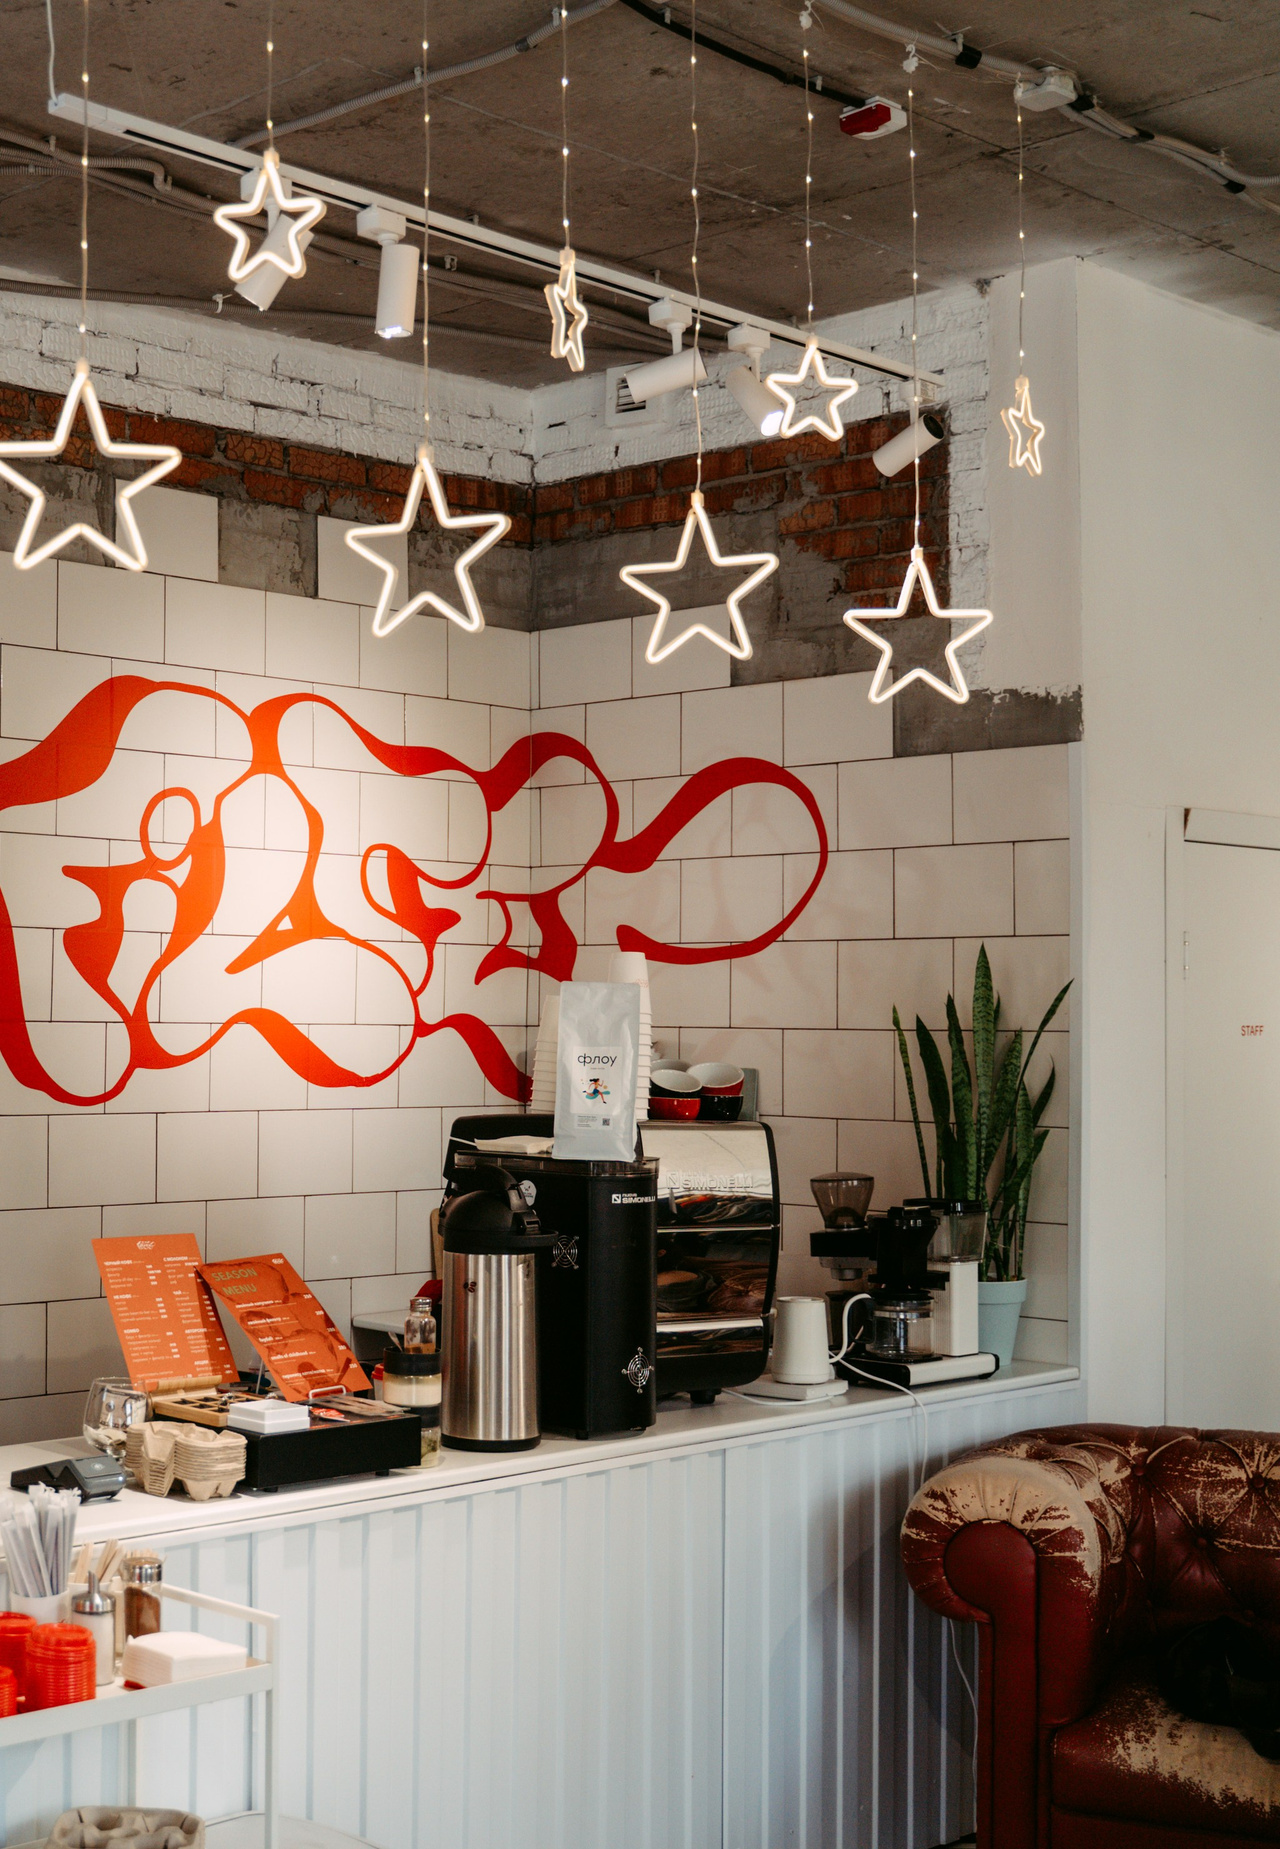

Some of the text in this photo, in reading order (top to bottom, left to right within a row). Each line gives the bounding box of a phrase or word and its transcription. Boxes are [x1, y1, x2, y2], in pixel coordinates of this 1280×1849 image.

[1241, 1025, 1264, 1036] STAFF
[577, 1053, 617, 1067] флоу
[681, 1173, 754, 1190] SIMONELLI
[211, 1268, 258, 1281] SEASON
[222, 1283, 257, 1295] MENU
